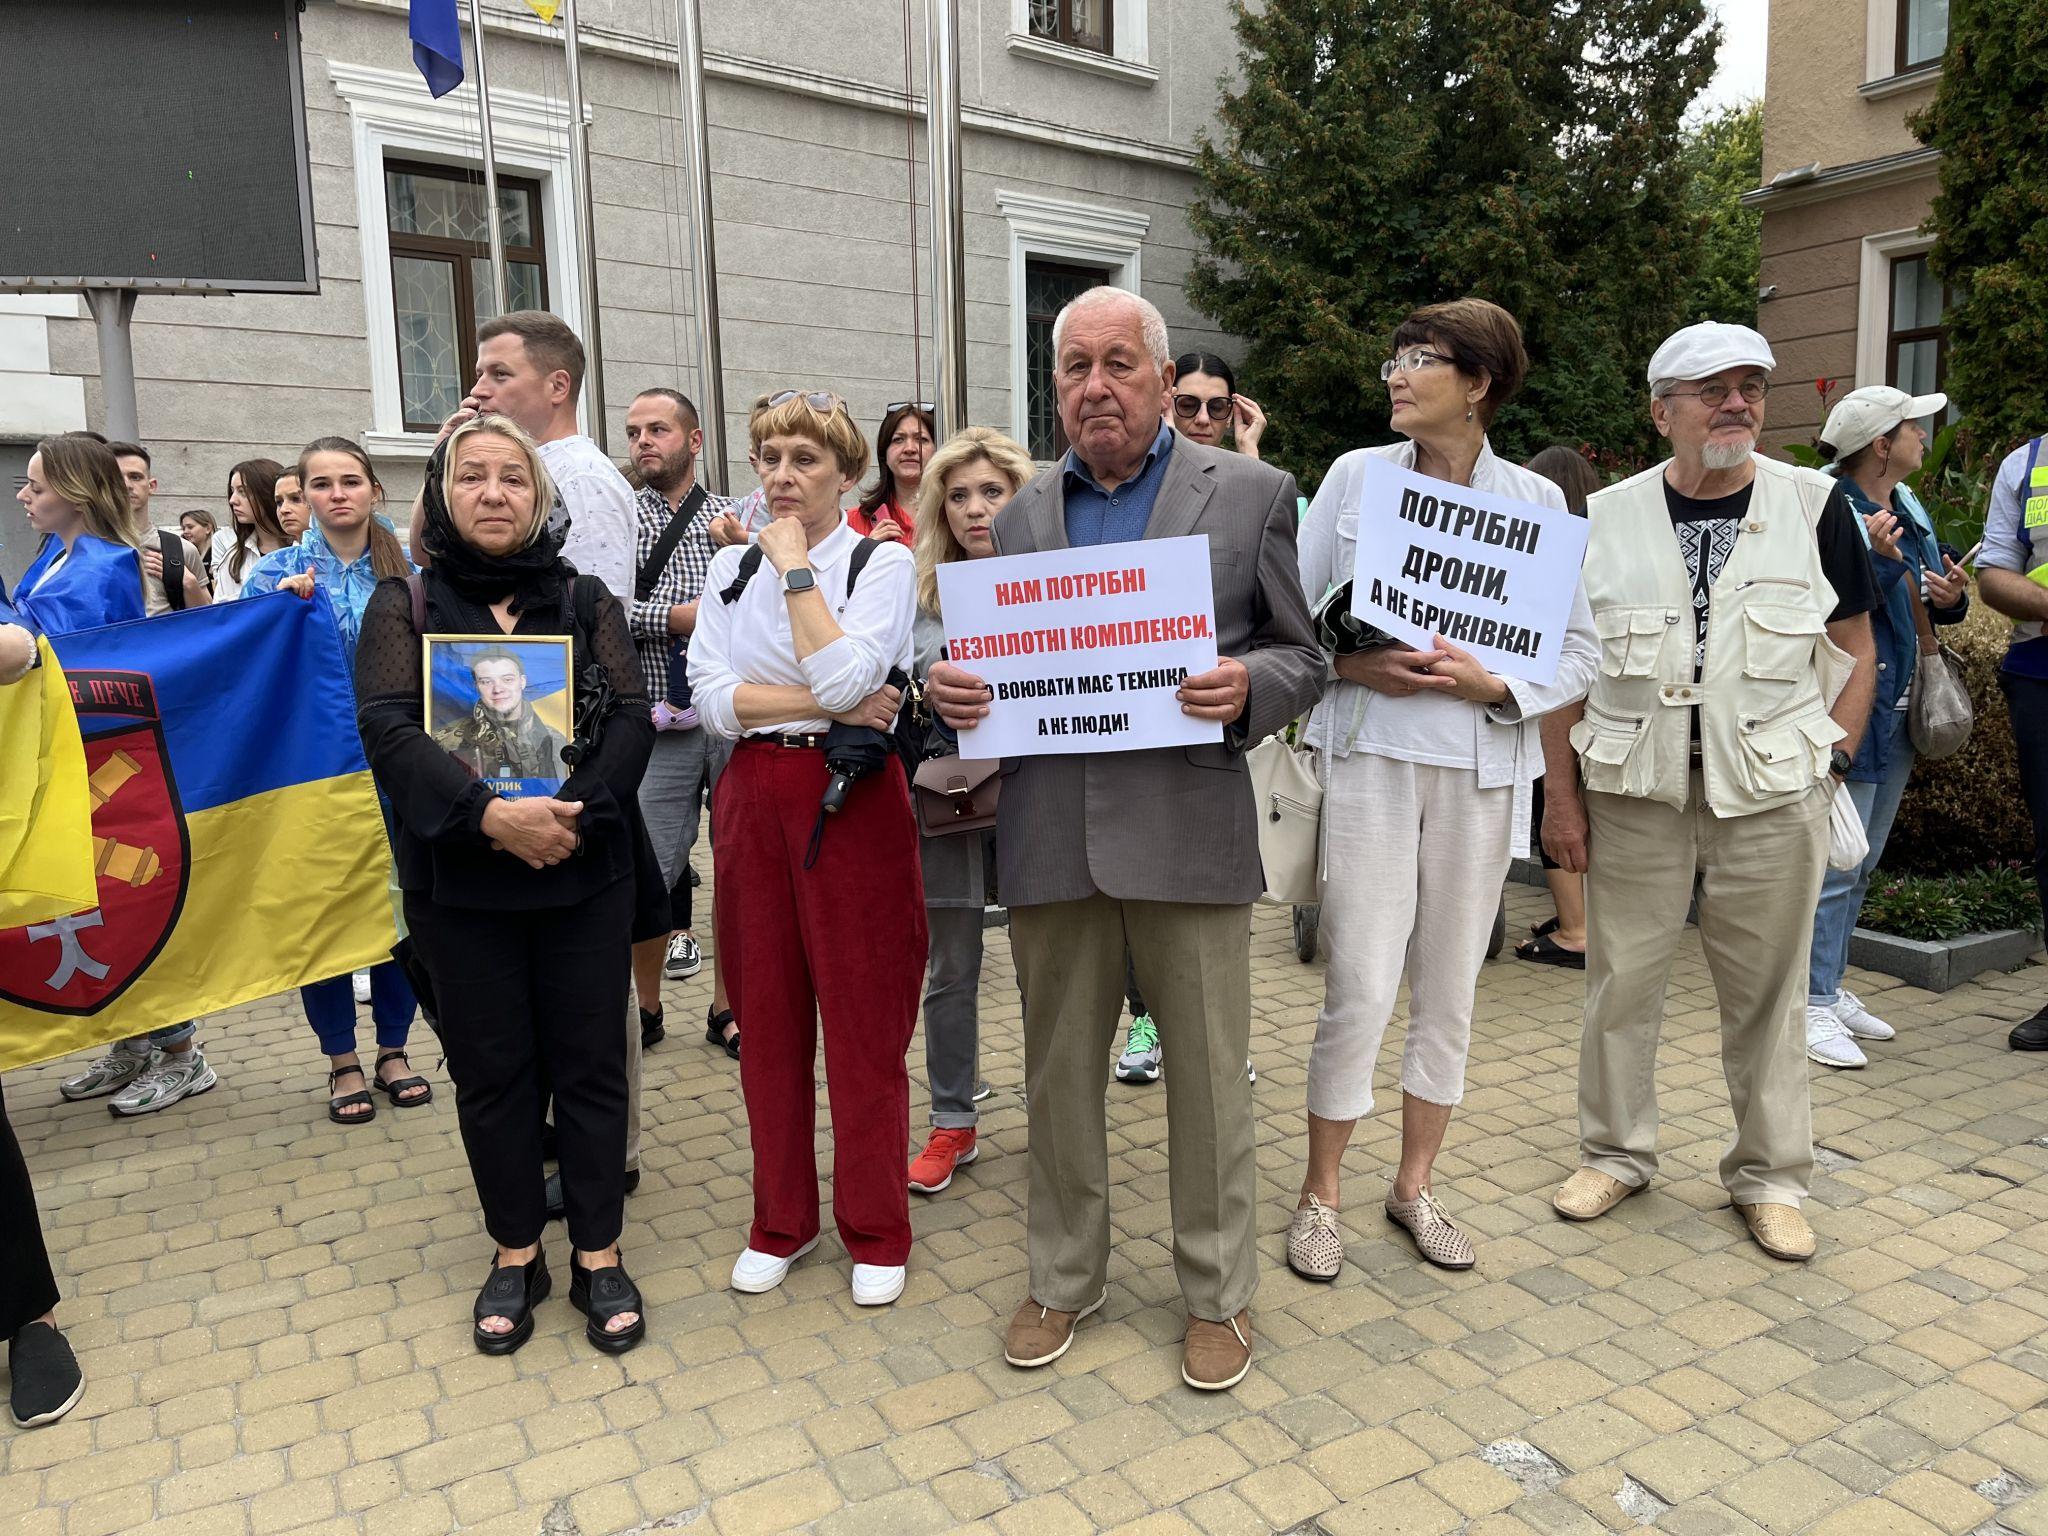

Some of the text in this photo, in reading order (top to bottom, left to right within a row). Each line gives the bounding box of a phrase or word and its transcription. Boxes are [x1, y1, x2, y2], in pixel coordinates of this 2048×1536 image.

[1399, 487, 1541, 554] ПОТРІБНІ
[995, 567, 1146, 606] НАМ ПОТРІБНІ
[1401, 544, 1509, 606] ДРОНИ,
[949, 614, 1213, 661] БЕЗПІЛОТНІ КОМПЛЕКСИ,
[1370, 578, 1542, 658] А НЕ БРУКІВКА!
[68, 679, 144, 707] Е ПЕЧЕ
[998, 677, 1075, 700] ВОЮВАТИ
[1078, 674, 1113, 695] МАЄ
[1116, 666, 1188, 690] ТЕХНІКА
[1038, 713, 1129, 736] А НЕ ЛЮДИ!
[484, 779, 522, 794] урик
